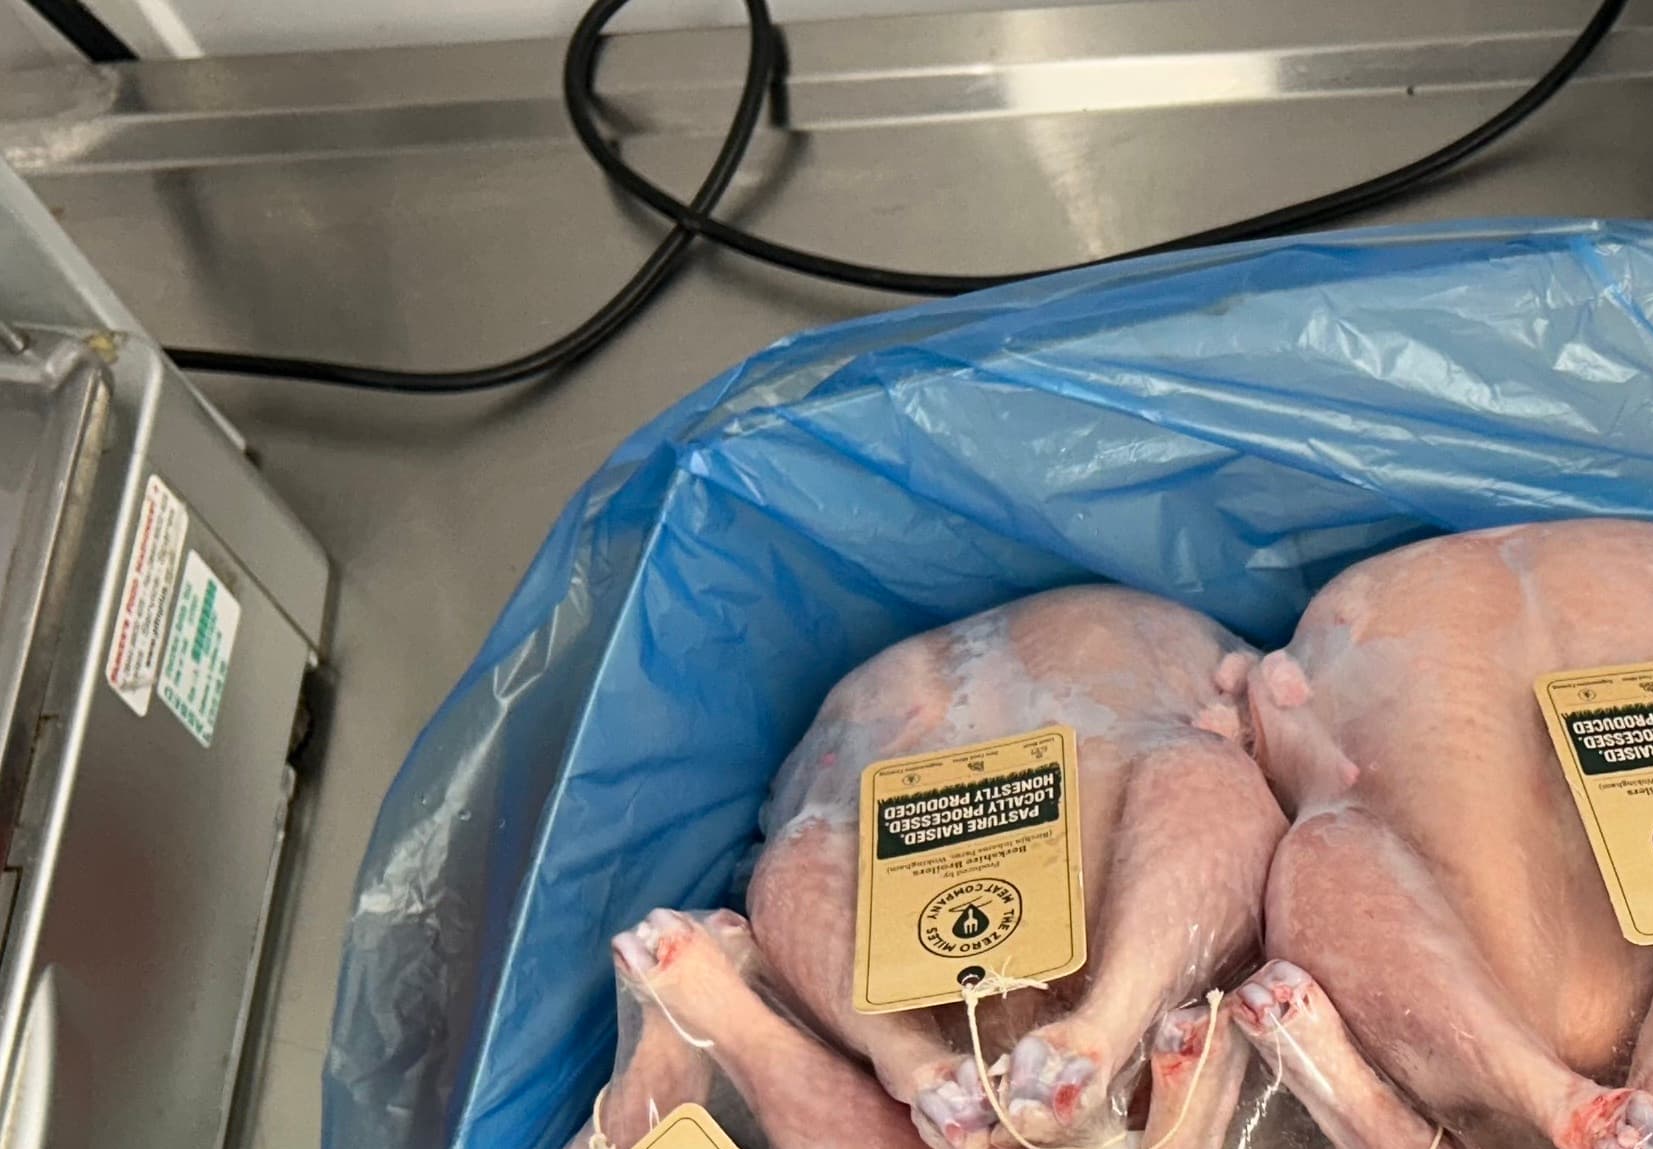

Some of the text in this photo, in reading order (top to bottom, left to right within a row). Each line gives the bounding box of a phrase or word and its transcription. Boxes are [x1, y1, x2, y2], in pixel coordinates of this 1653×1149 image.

[883, 773, 1054, 821] HONESTLY PRODUCED
[884, 787, 1054, 834] LOCALLY PROCESSED.
[900, 805, 1039, 846] PASTURE RAISED.
[912, 846, 1028, 877] Berkshire Broilers
[926, 883, 1015, 920] MEAT COMPANY
[926, 908, 1015, 953] THE ZERO MILES
